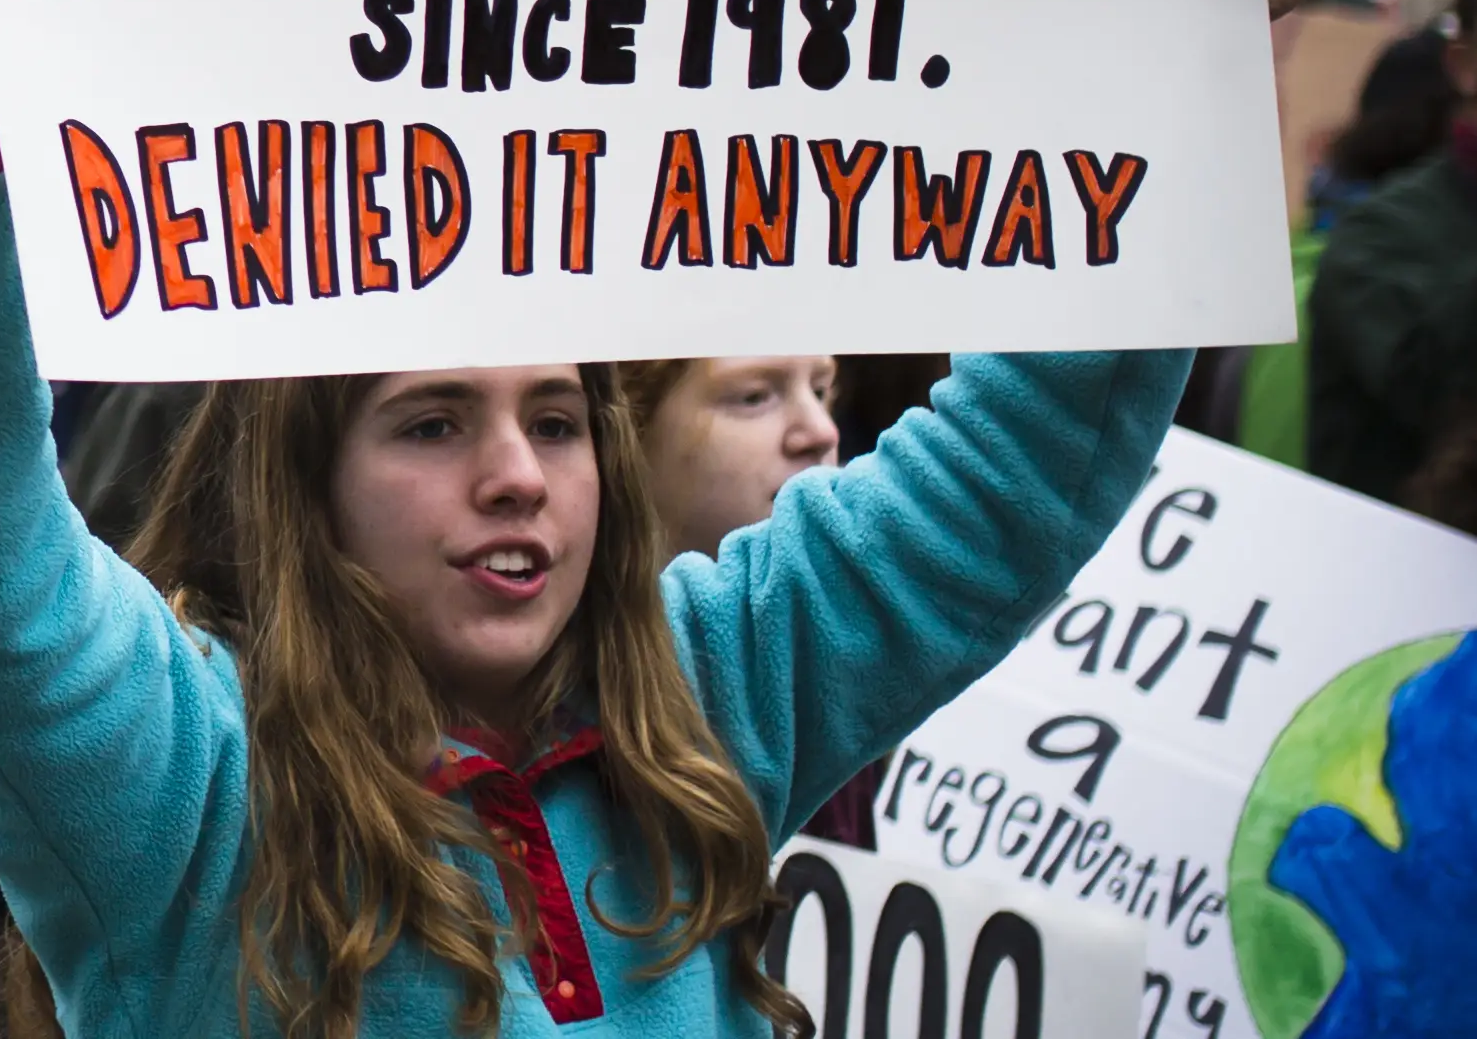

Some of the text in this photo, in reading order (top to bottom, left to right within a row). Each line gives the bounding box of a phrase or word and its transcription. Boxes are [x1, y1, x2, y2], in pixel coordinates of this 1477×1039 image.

[59, 118, 1149, 320] DENIED IT ANYWAY
